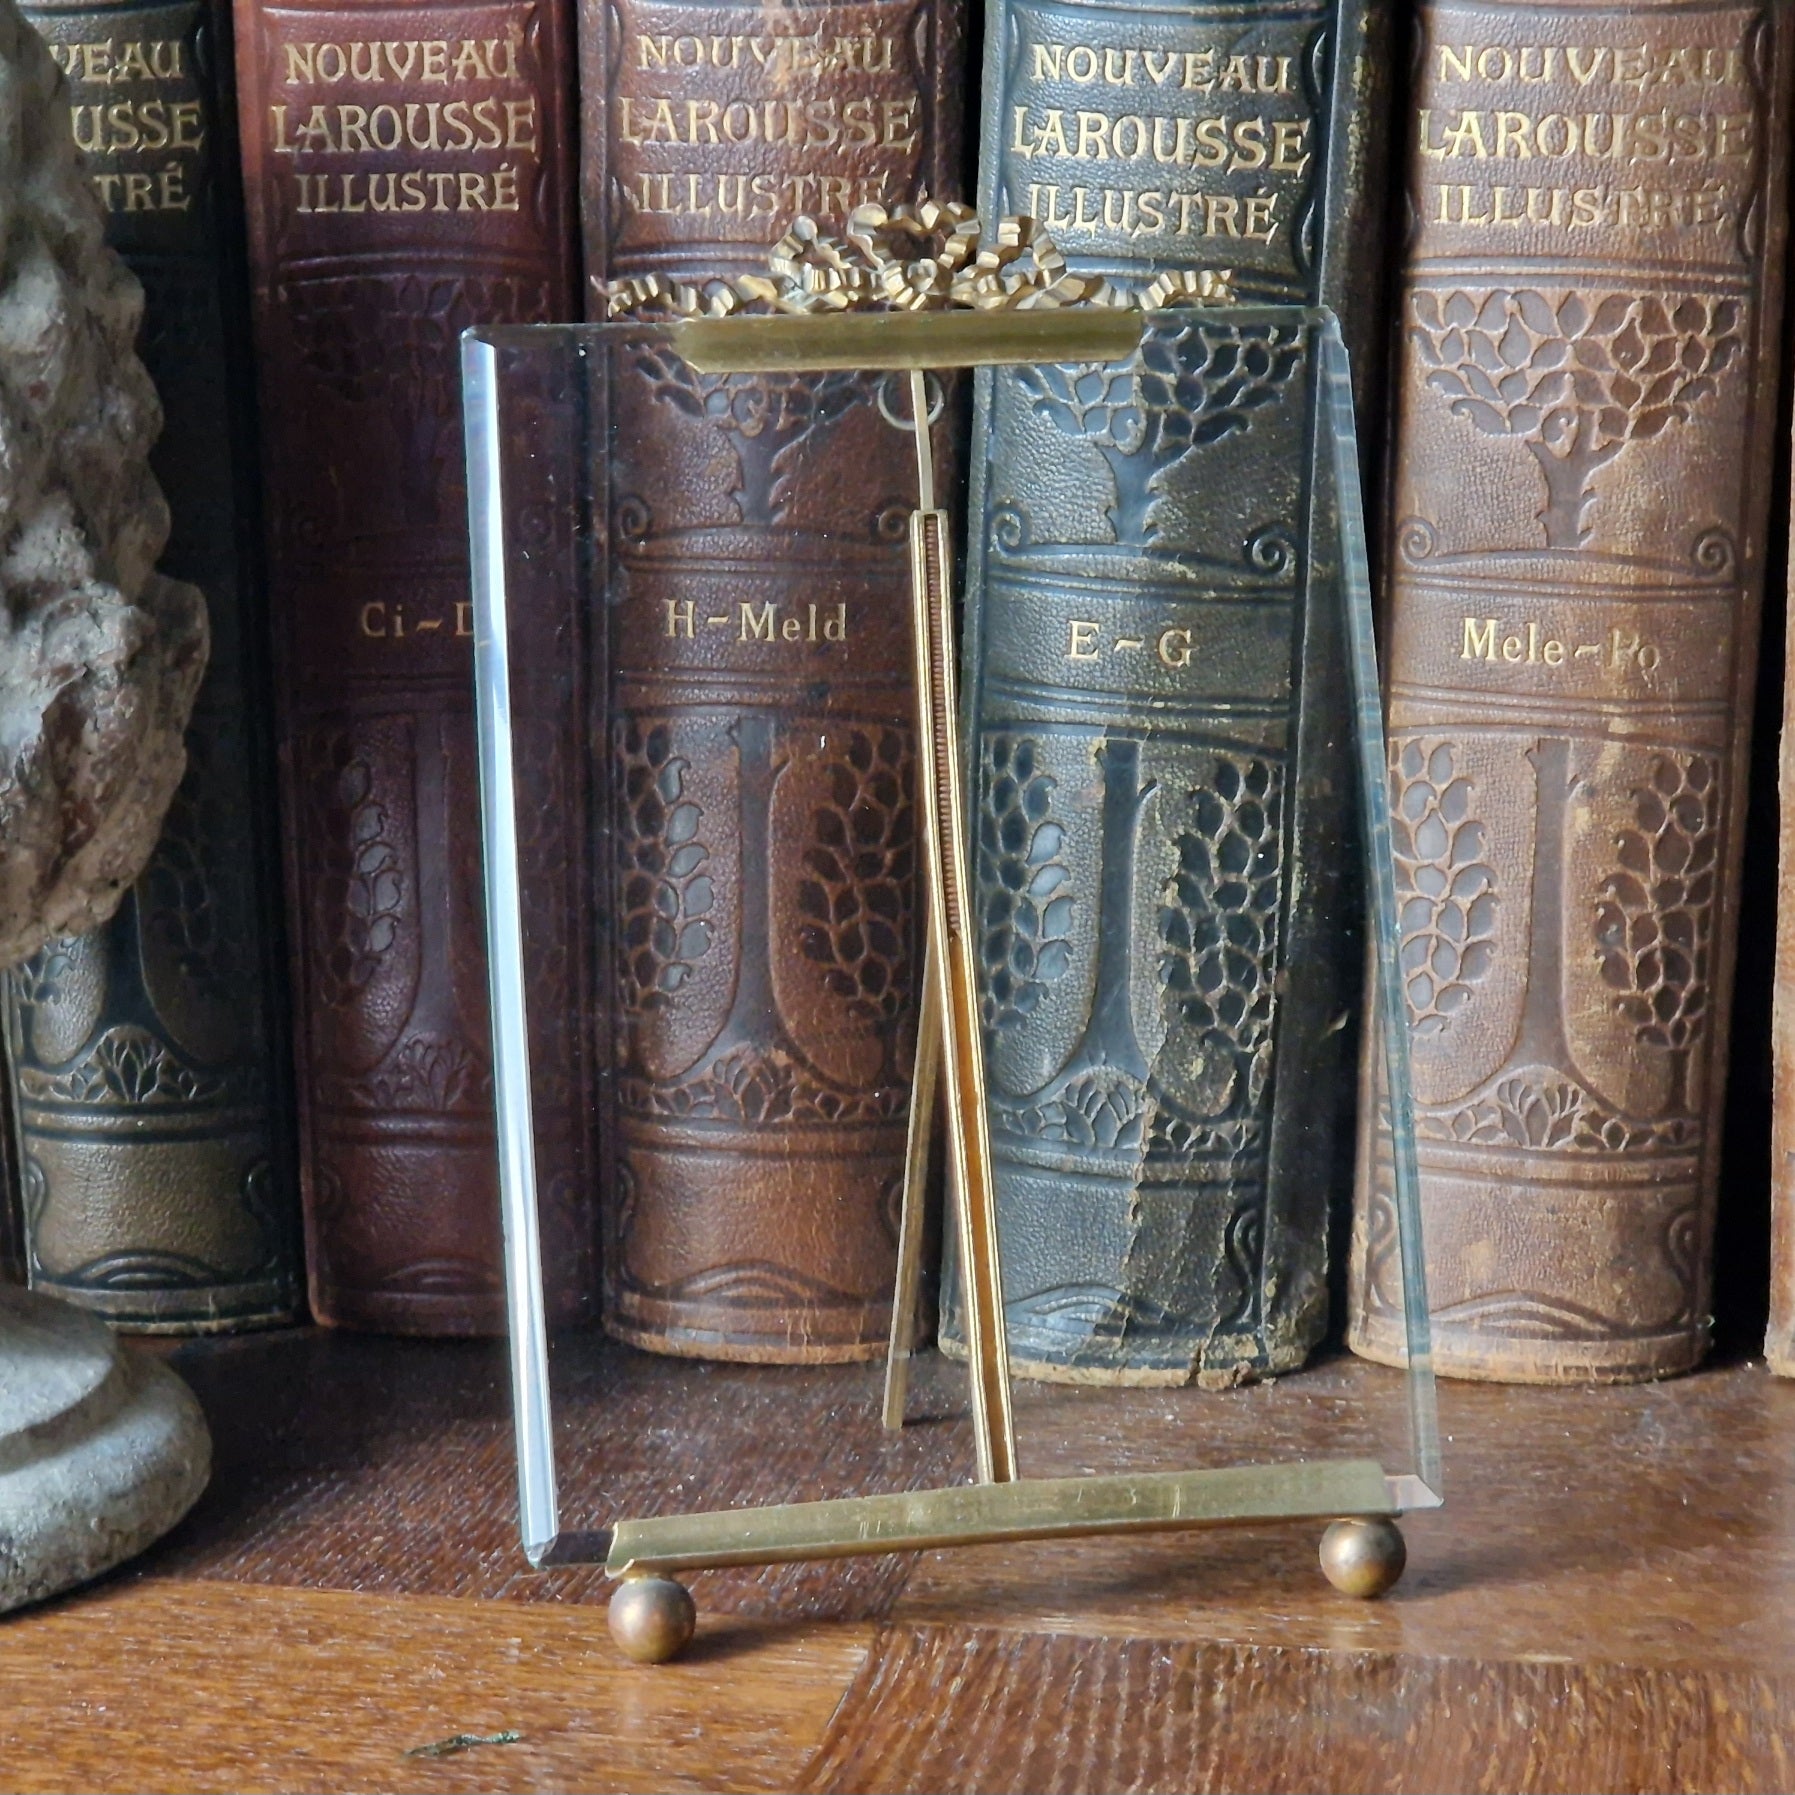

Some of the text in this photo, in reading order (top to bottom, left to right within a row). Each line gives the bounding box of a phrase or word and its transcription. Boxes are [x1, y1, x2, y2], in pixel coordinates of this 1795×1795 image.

[48, 38, 184, 85] VEAU
[284, 39, 521, 87] NOUVEAU
[635, 34, 894, 76] NOUVEAU
[1030, 43, 1294, 100] NOUVEAU
[1438, 42, 1747, 90] NOUVEAU
[70, 98, 205, 155] USSE
[271, 96, 537, 154] LAROUSSE
[620, 96, 918, 152] LAROUSSE
[1011, 106, 1311, 177] LAROUSSE
[1419, 108, 1755, 165] LAROUSSE
[295, 162, 521, 213] ILLUSTRÉ
[1433, 179, 1729, 233] ILLUSTRÉ
[1029, 183, 1280, 249] ILLUSTRÉ
